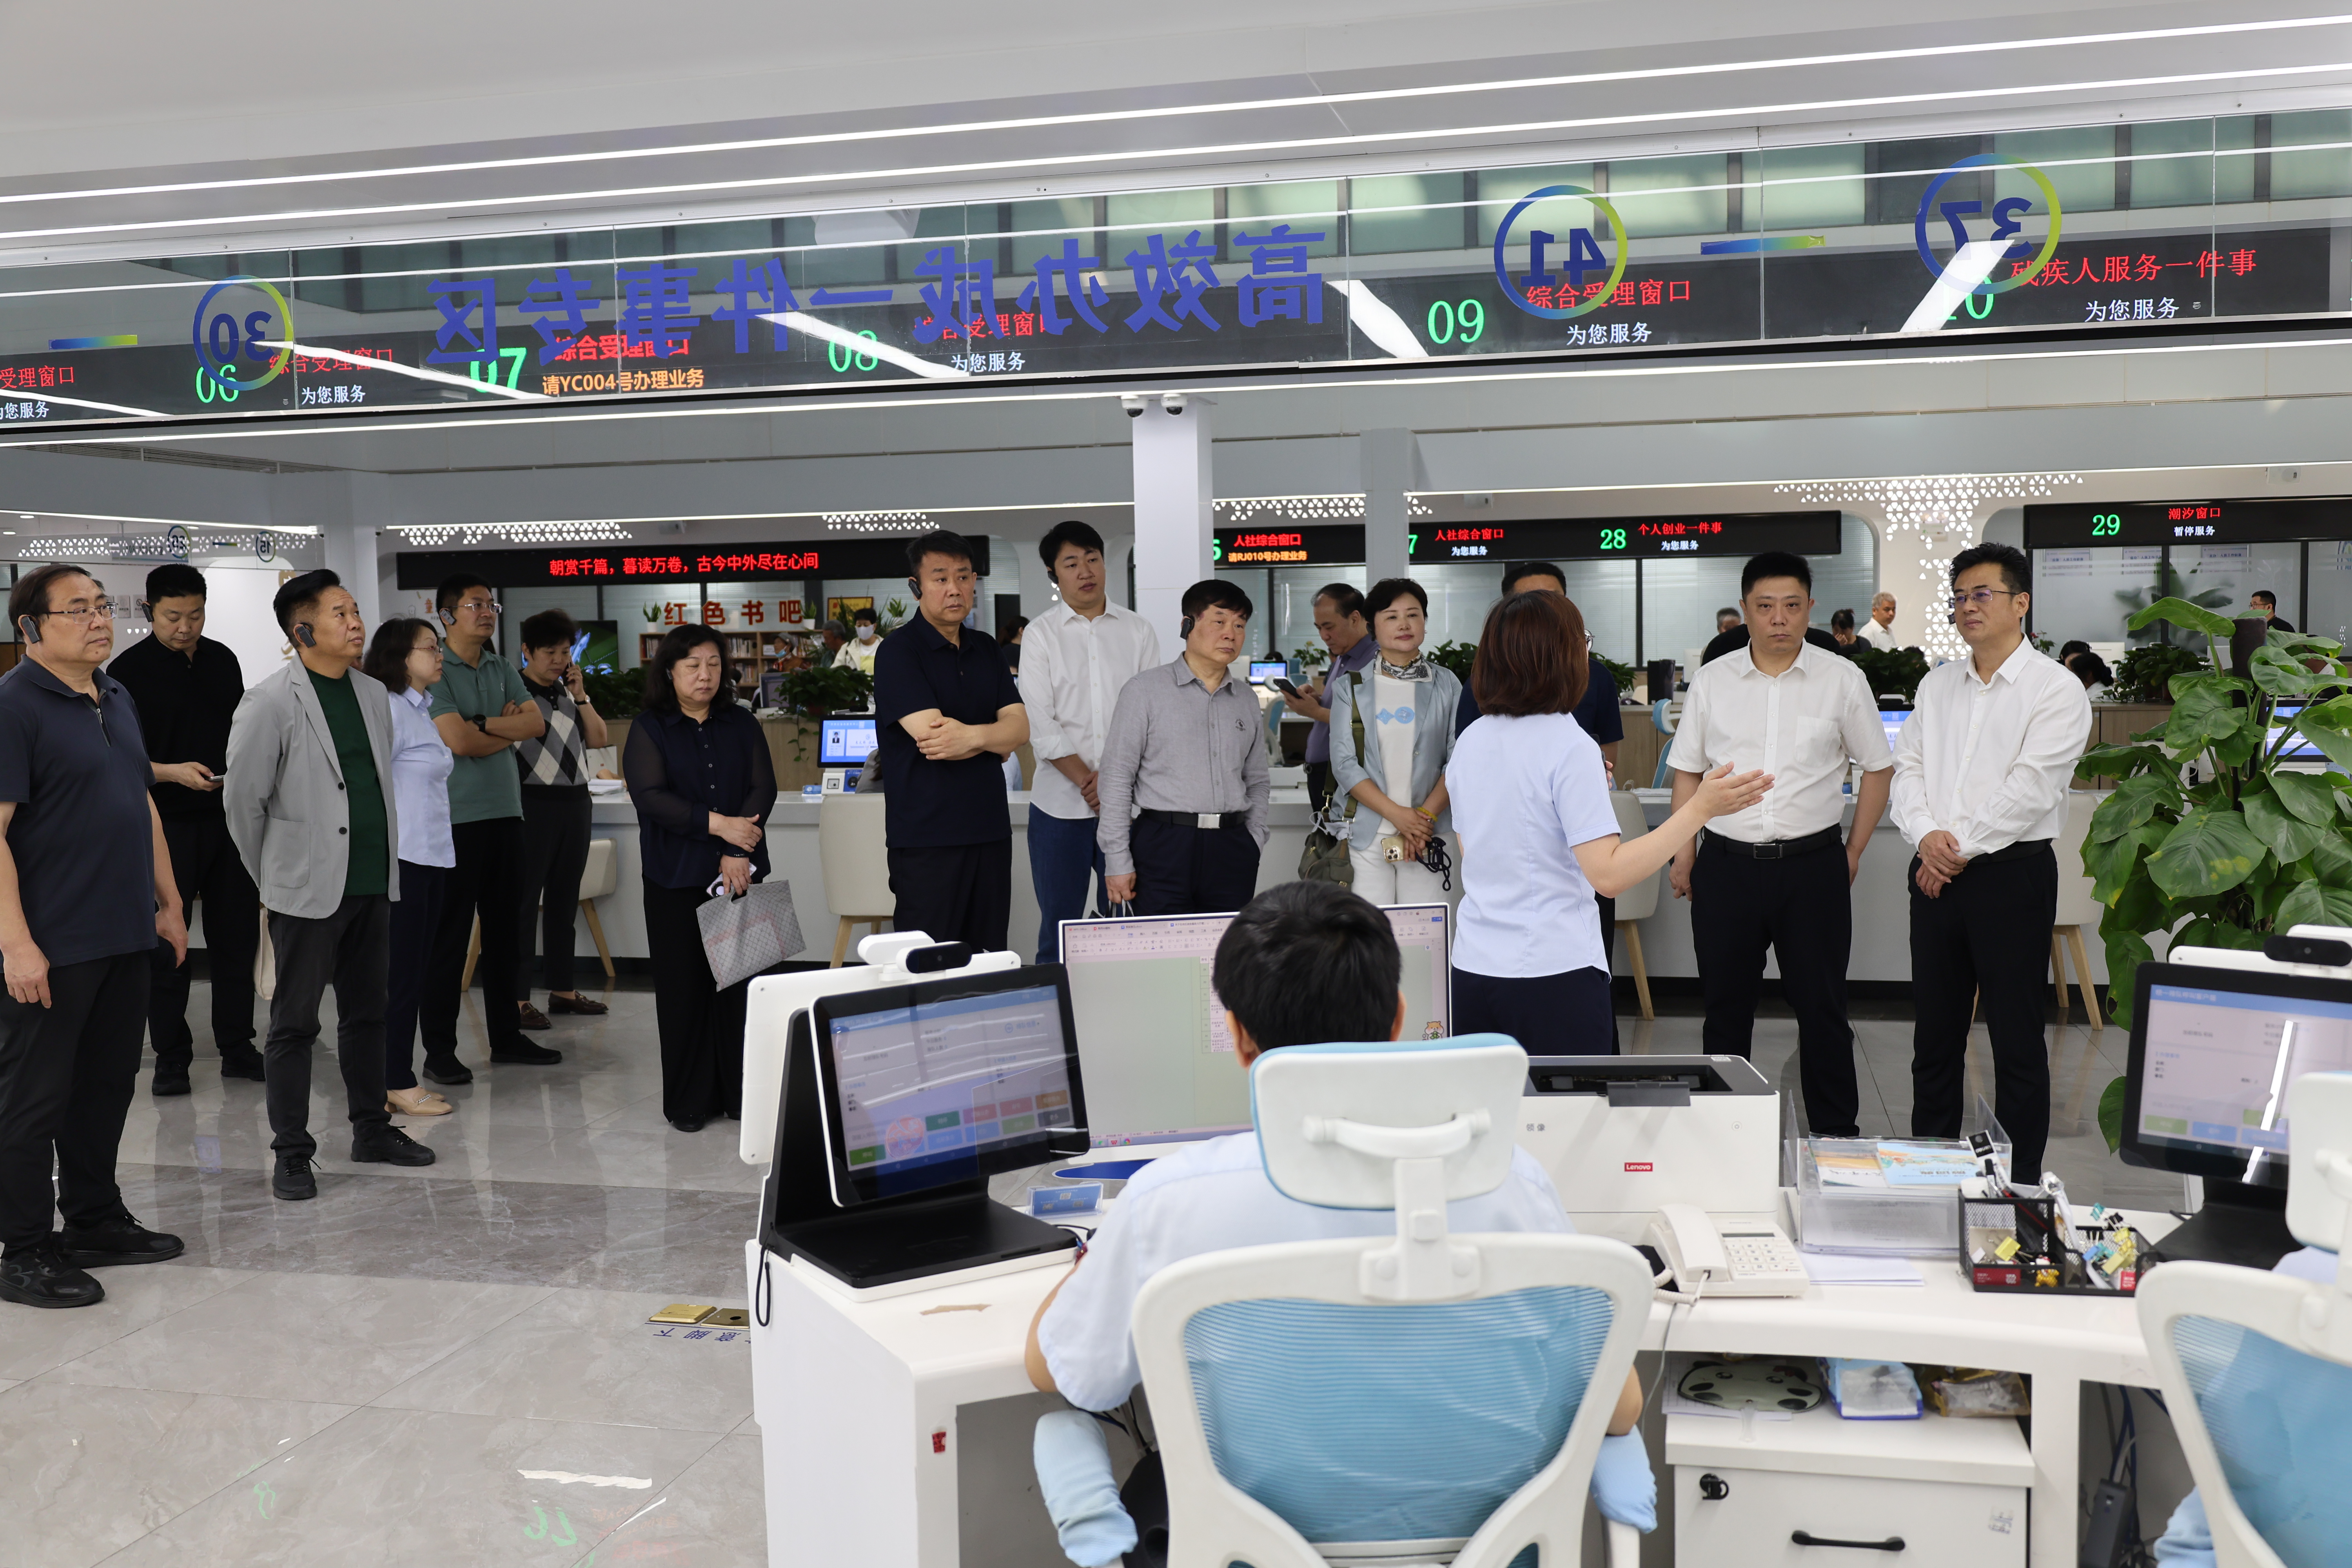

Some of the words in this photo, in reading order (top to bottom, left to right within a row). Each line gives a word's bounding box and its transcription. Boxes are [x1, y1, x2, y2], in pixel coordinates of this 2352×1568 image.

[2010, 249, 2257, 287] 残疾人服务一件事
[1527, 279, 1691, 310] 综合受理窗口
[2085, 297, 2179, 322] 为您服务
[1427, 299, 1485, 344] 09
[1567, 322, 1652, 346] 为您服务
[828, 330, 879, 372] 08
[951, 351, 1025, 373] 为您服务
[0, 365, 74, 390] 受理窗口
[470, 347, 527, 392] 07
[195, 363, 239, 404] 06
[542, 368, 704, 395] 请YC004号办理业务
[301, 384, 366, 405] 为您服务
[0, 400, 49, 420] 您服务
[2168, 506, 2221, 521] 潮汐窗口
[1435, 528, 1504, 541] 人社综合窗口
[1638, 521, 1722, 535] 个人创业一件事
[2091, 514, 2120, 536] 29
[2174, 525, 2215, 537] 暂停服务
[1233, 534, 1302, 548] 人社综合窗口
[1600, 528, 1627, 550] 28
[1661, 539, 1699, 551] 为您服务
[1451, 545, 1488, 556] 为您服务
[550, 552, 818, 576] 朝赏千篇，暮读万卷，古今中外尽在心间
[664, 599, 802, 626] 红色书吧
[1526, 1123, 1546, 1132] 领像
